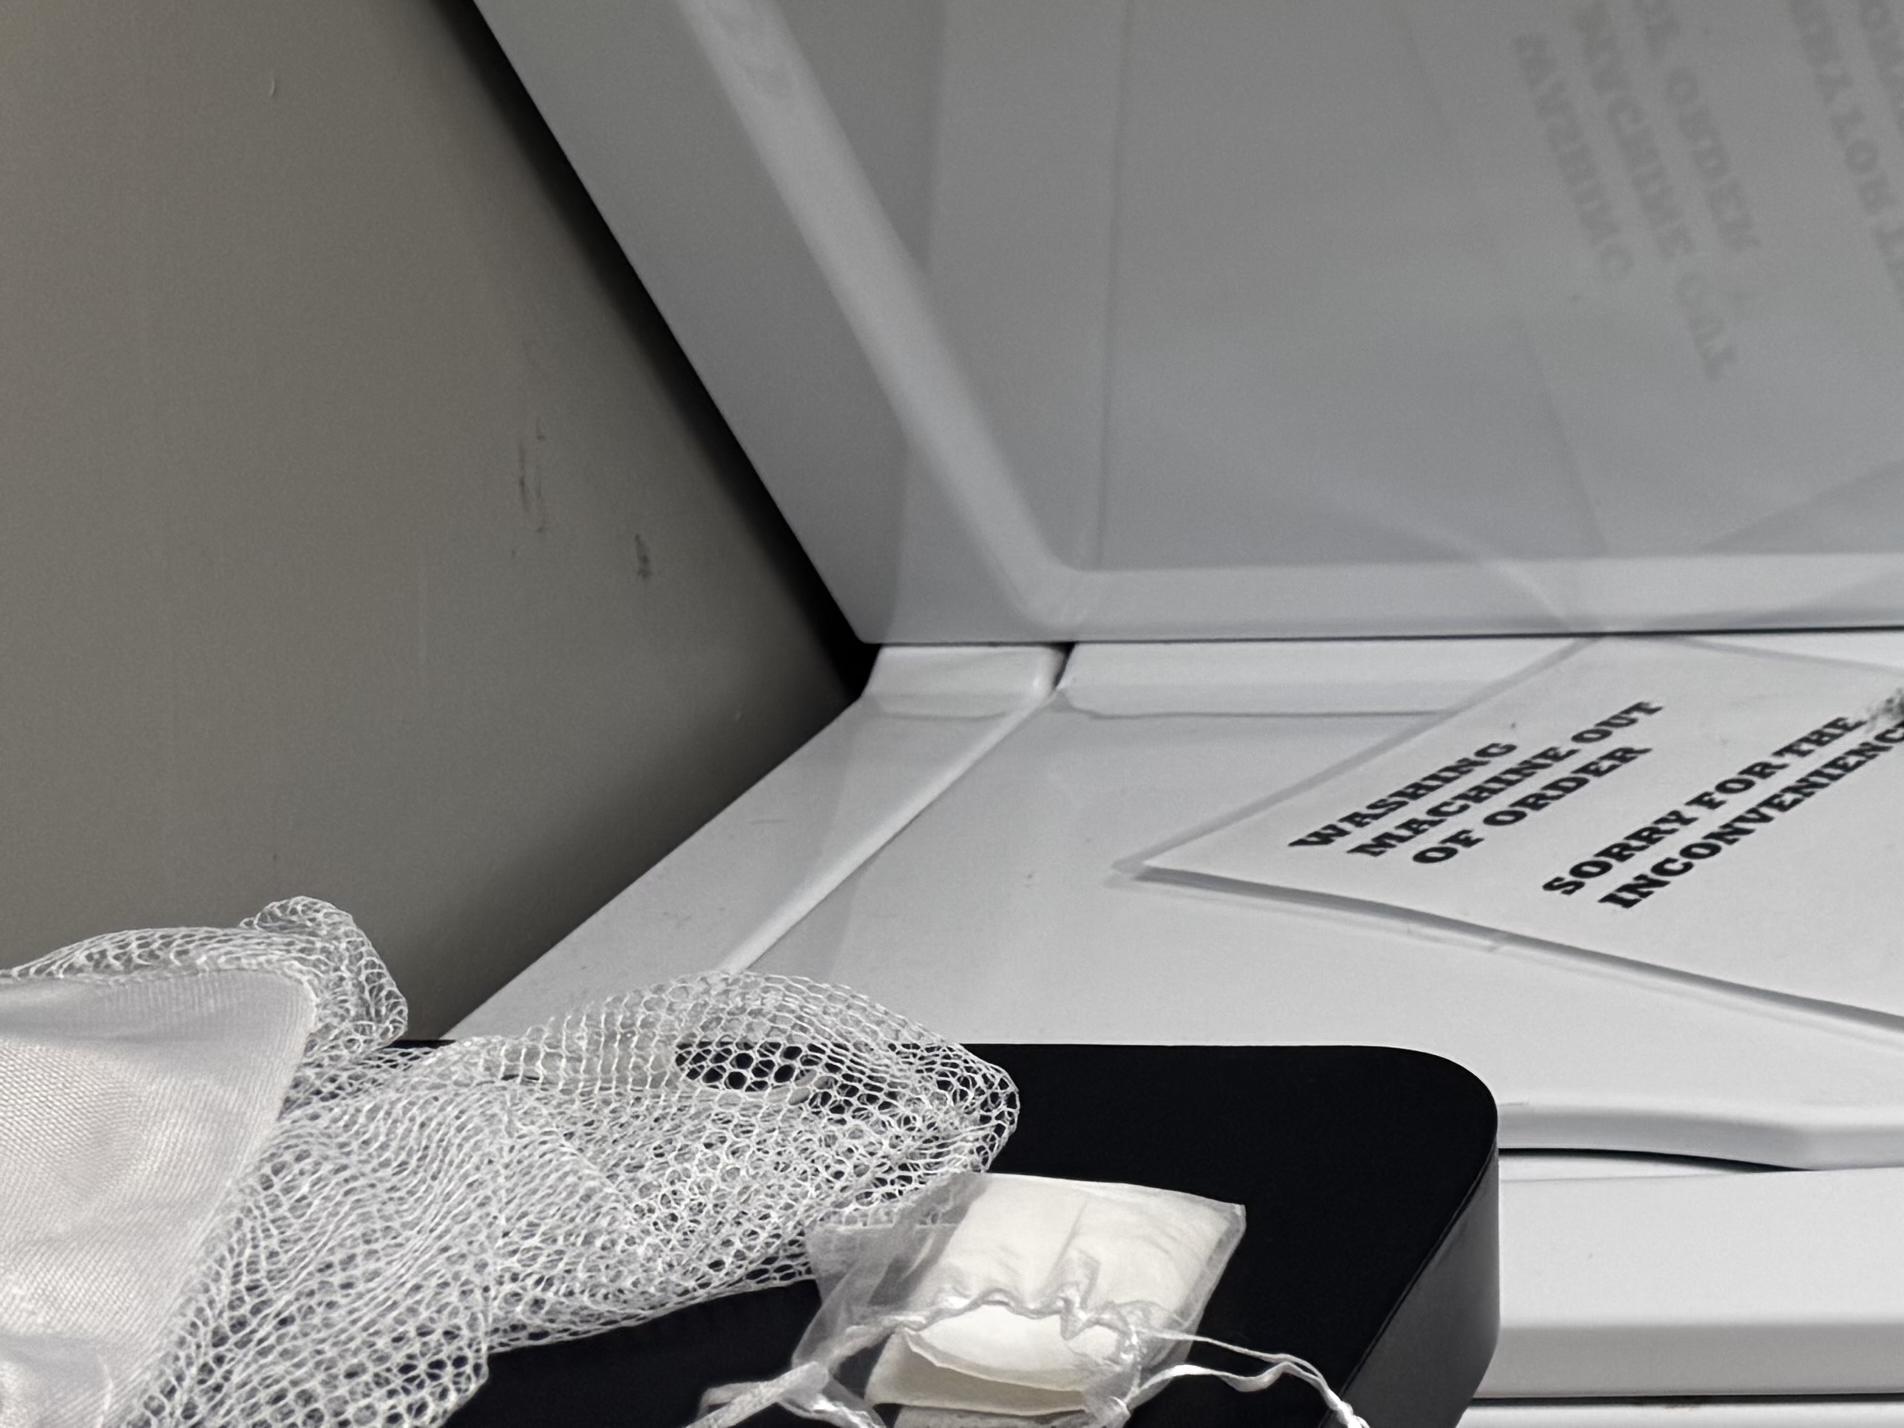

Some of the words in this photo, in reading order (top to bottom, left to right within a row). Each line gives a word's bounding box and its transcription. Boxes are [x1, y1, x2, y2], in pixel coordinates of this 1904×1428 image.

[1289, 741, 1520, 851] WASHING
[1346, 741, 1580, 859] MACHINE
[1571, 700, 1666, 746] OUT
[1411, 826, 1486, 865] OF
[1482, 745, 1653, 832] ORDER
[1541, 806, 1699, 897] SORRY
[1689, 756, 1784, 810] FOR
[1773, 715, 1865, 769] THE
